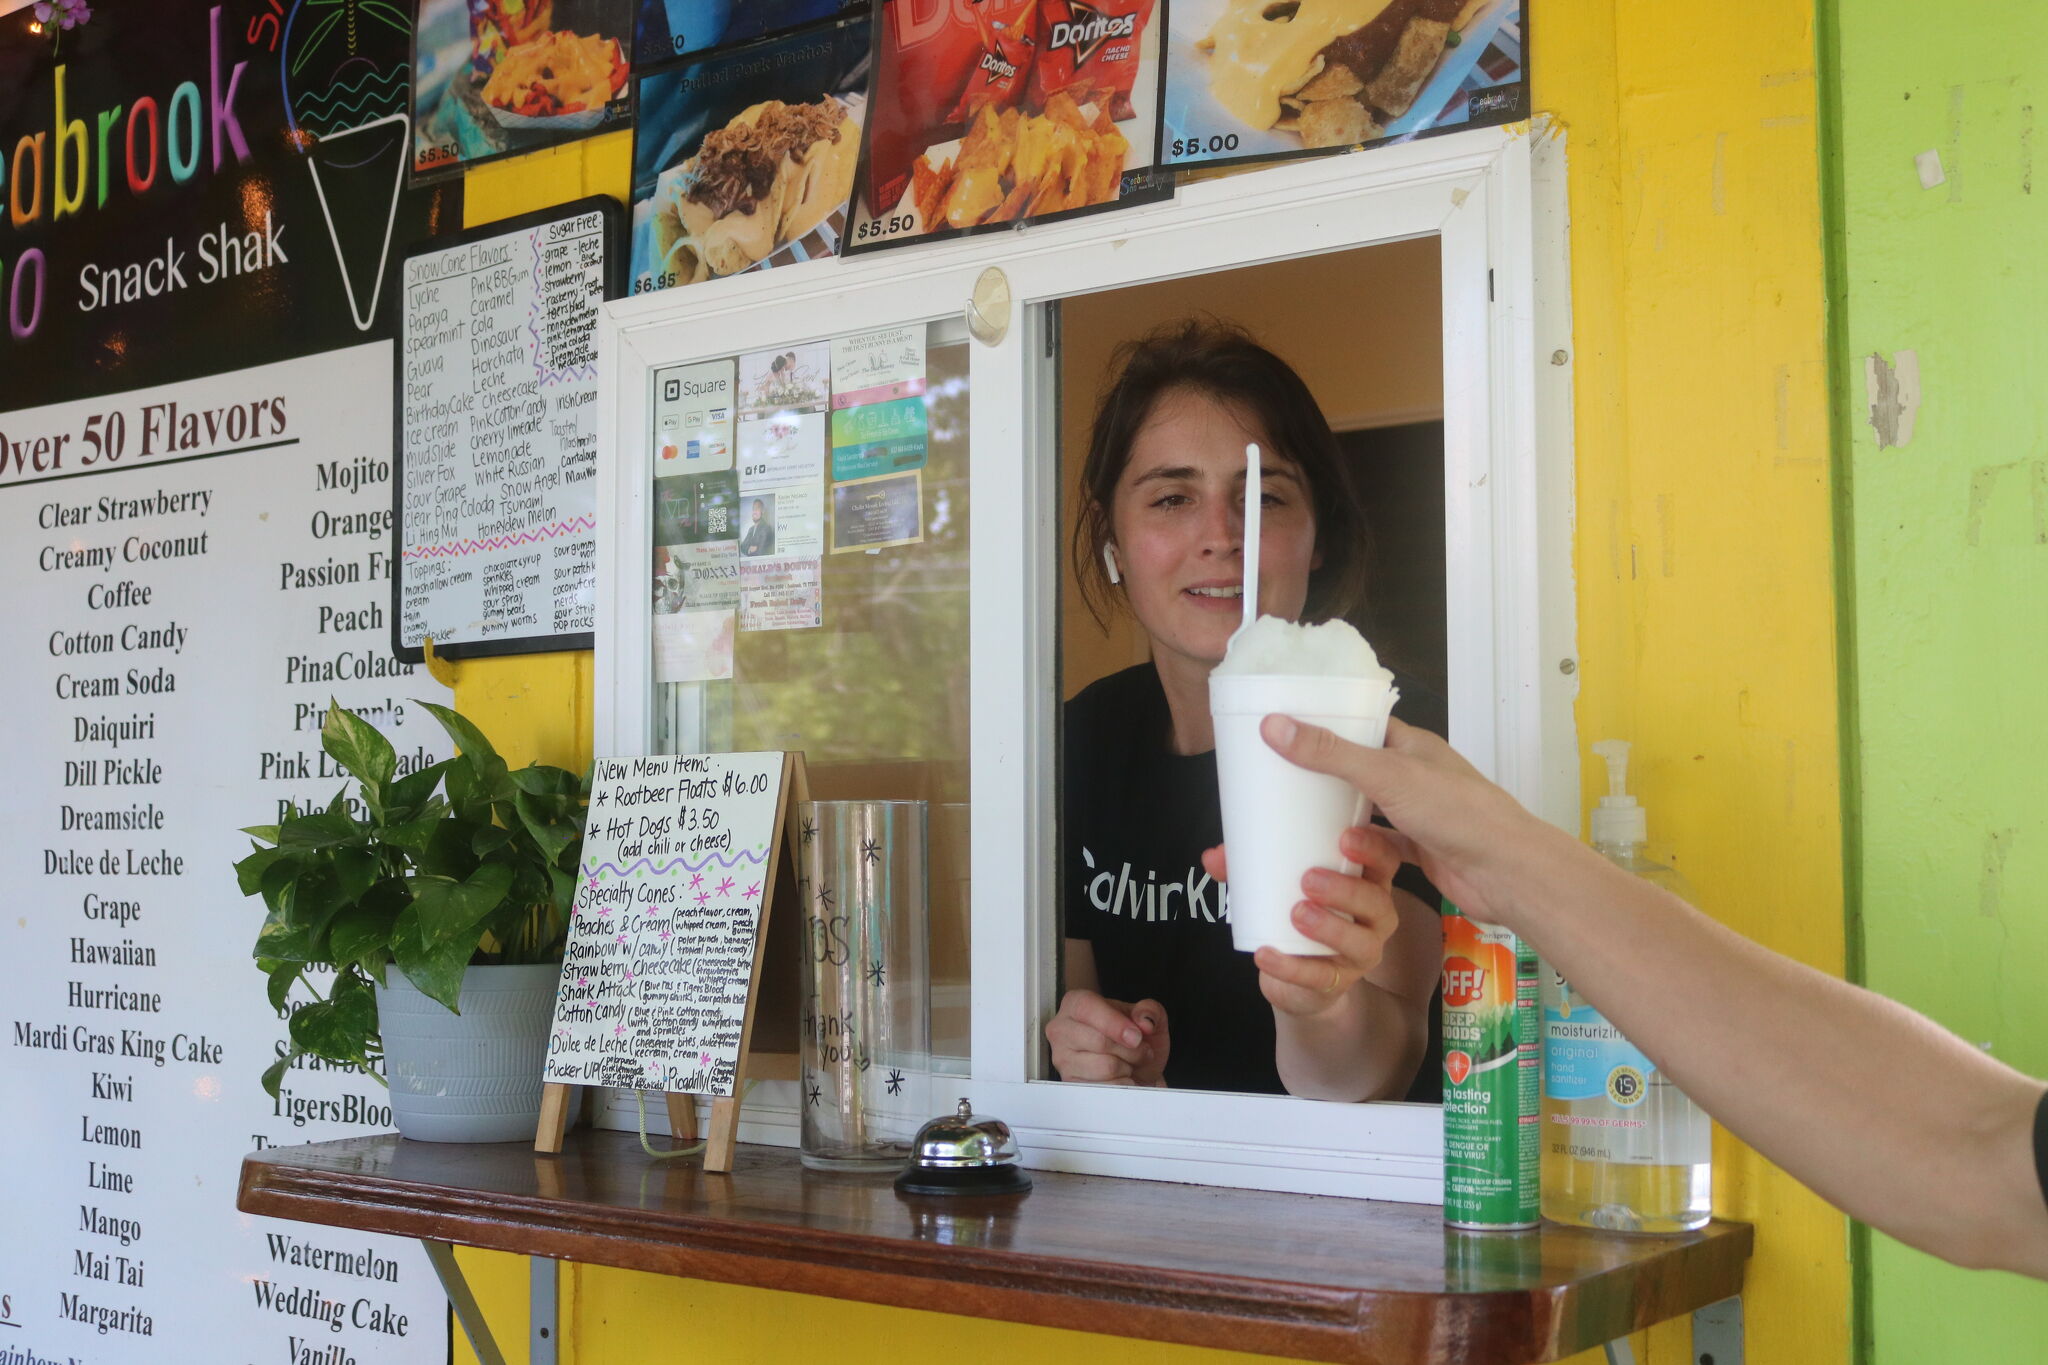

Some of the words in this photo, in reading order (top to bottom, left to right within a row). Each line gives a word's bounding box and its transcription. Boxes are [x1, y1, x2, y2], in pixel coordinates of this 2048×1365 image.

[1051, 12, 1136, 50] Doritos
[981, 54, 1016, 79] Doritos
[0, 5, 250, 229] abrook
[1172, 133, 1239, 157] $5.00
[857, 214, 914, 240] $5.50
[79, 236, 188, 312] Snack
[198, 210, 289, 284] Shak
[634, 271, 676, 295] $6.95
[471, 325, 522, 356] Dinosaur
[683, 379, 727, 397] Square
[81, 410, 125, 466] 50
[138, 395, 287, 457] Flavors
[711, 412, 726, 421] VISA
[316, 456, 390, 494] Mojito
[39, 503, 92, 530] Clear
[97, 489, 213, 523] Strawberry
[311, 509, 393, 541] Orange
[39, 546, 117, 573] Creamy
[123, 531, 208, 563] Coconut
[280, 557, 360, 590] Passion
[88, 580, 152, 610] Coffee
[318, 601, 383, 634] Peach
[49, 631, 114, 657] Cotton
[121, 622, 188, 654] Candy
[56, 673, 120, 699] Cream
[126, 667, 176, 696] Soda
[74, 712, 155, 748] Daiquiri
[64, 761, 97, 787] Dill
[103, 758, 163, 786] Pickle
[259, 752, 311, 780] Pink
[597, 760, 628, 782] New
[632, 757, 669, 777] Menu
[614, 784, 675, 809] Rootbeer
[677, 777, 718, 803] Floats
[722, 770, 769, 798] $6.00
[60, 803, 165, 831] Dreamsicle
[606, 816, 634, 841] Hot
[638, 815, 672, 840] Dogs
[677, 805, 720, 830] $3.50
[617, 838, 643, 864] (add
[647, 838, 671, 856] chili
[674, 841, 686, 853] or
[690, 828, 732, 852] cheese)
[43, 849, 94, 876] Dulce
[99, 849, 121, 875] de
[126, 849, 184, 876] Leche
[83, 893, 141, 929] Grape
[578, 880, 635, 912] Specialty
[573, 914, 615, 939] Peaches
[70, 937, 157, 967] Hawaiian
[569, 941, 618, 961] Rainbow
[67, 981, 162, 1013] Hurricane
[560, 983, 595, 1003] Shark
[596, 980, 635, 1001] Attack
[557, 1003, 594, 1024] Cotton
[13, 1020, 67, 1051] Mardi
[73, 1025, 116, 1056] Gras
[120, 1029, 167, 1067] King
[172, 1033, 224, 1065] Cake
[551, 1035, 581, 1055] Dulce
[584, 1036, 596, 1051] de
[599, 1033, 629, 1054] Leche
[1443, 1027, 1482, 1041] OODS
[1551, 1024, 1627, 1040] moisturizin
[547, 1059, 582, 1079] Pucker
[1551, 1047, 1598, 1060] original
[1551, 1063, 1575, 1073] hand
[91, 1071, 134, 1102] Kiwi
[1453, 1087, 1491, 1104] lasting
[1551, 1075, 1587, 1086] sanitizer
[1618, 1077, 1634, 1094] 15
[272, 1089, 397, 1127] TigersBloo
[81, 1115, 142, 1149] Lemon
[1464, 1151, 1486, 1160] VIRUS
[88, 1160, 133, 1194] Lime
[79, 1204, 141, 1247] Mango
[73, 1249, 110, 1282] Mai
[115, 1255, 145, 1288] Tai
[266, 1233, 399, 1283] Watermelon
[59, 1291, 154, 1337] Margarita
[252, 1279, 346, 1333] Wedding
[351, 1298, 409, 1337] Cake
